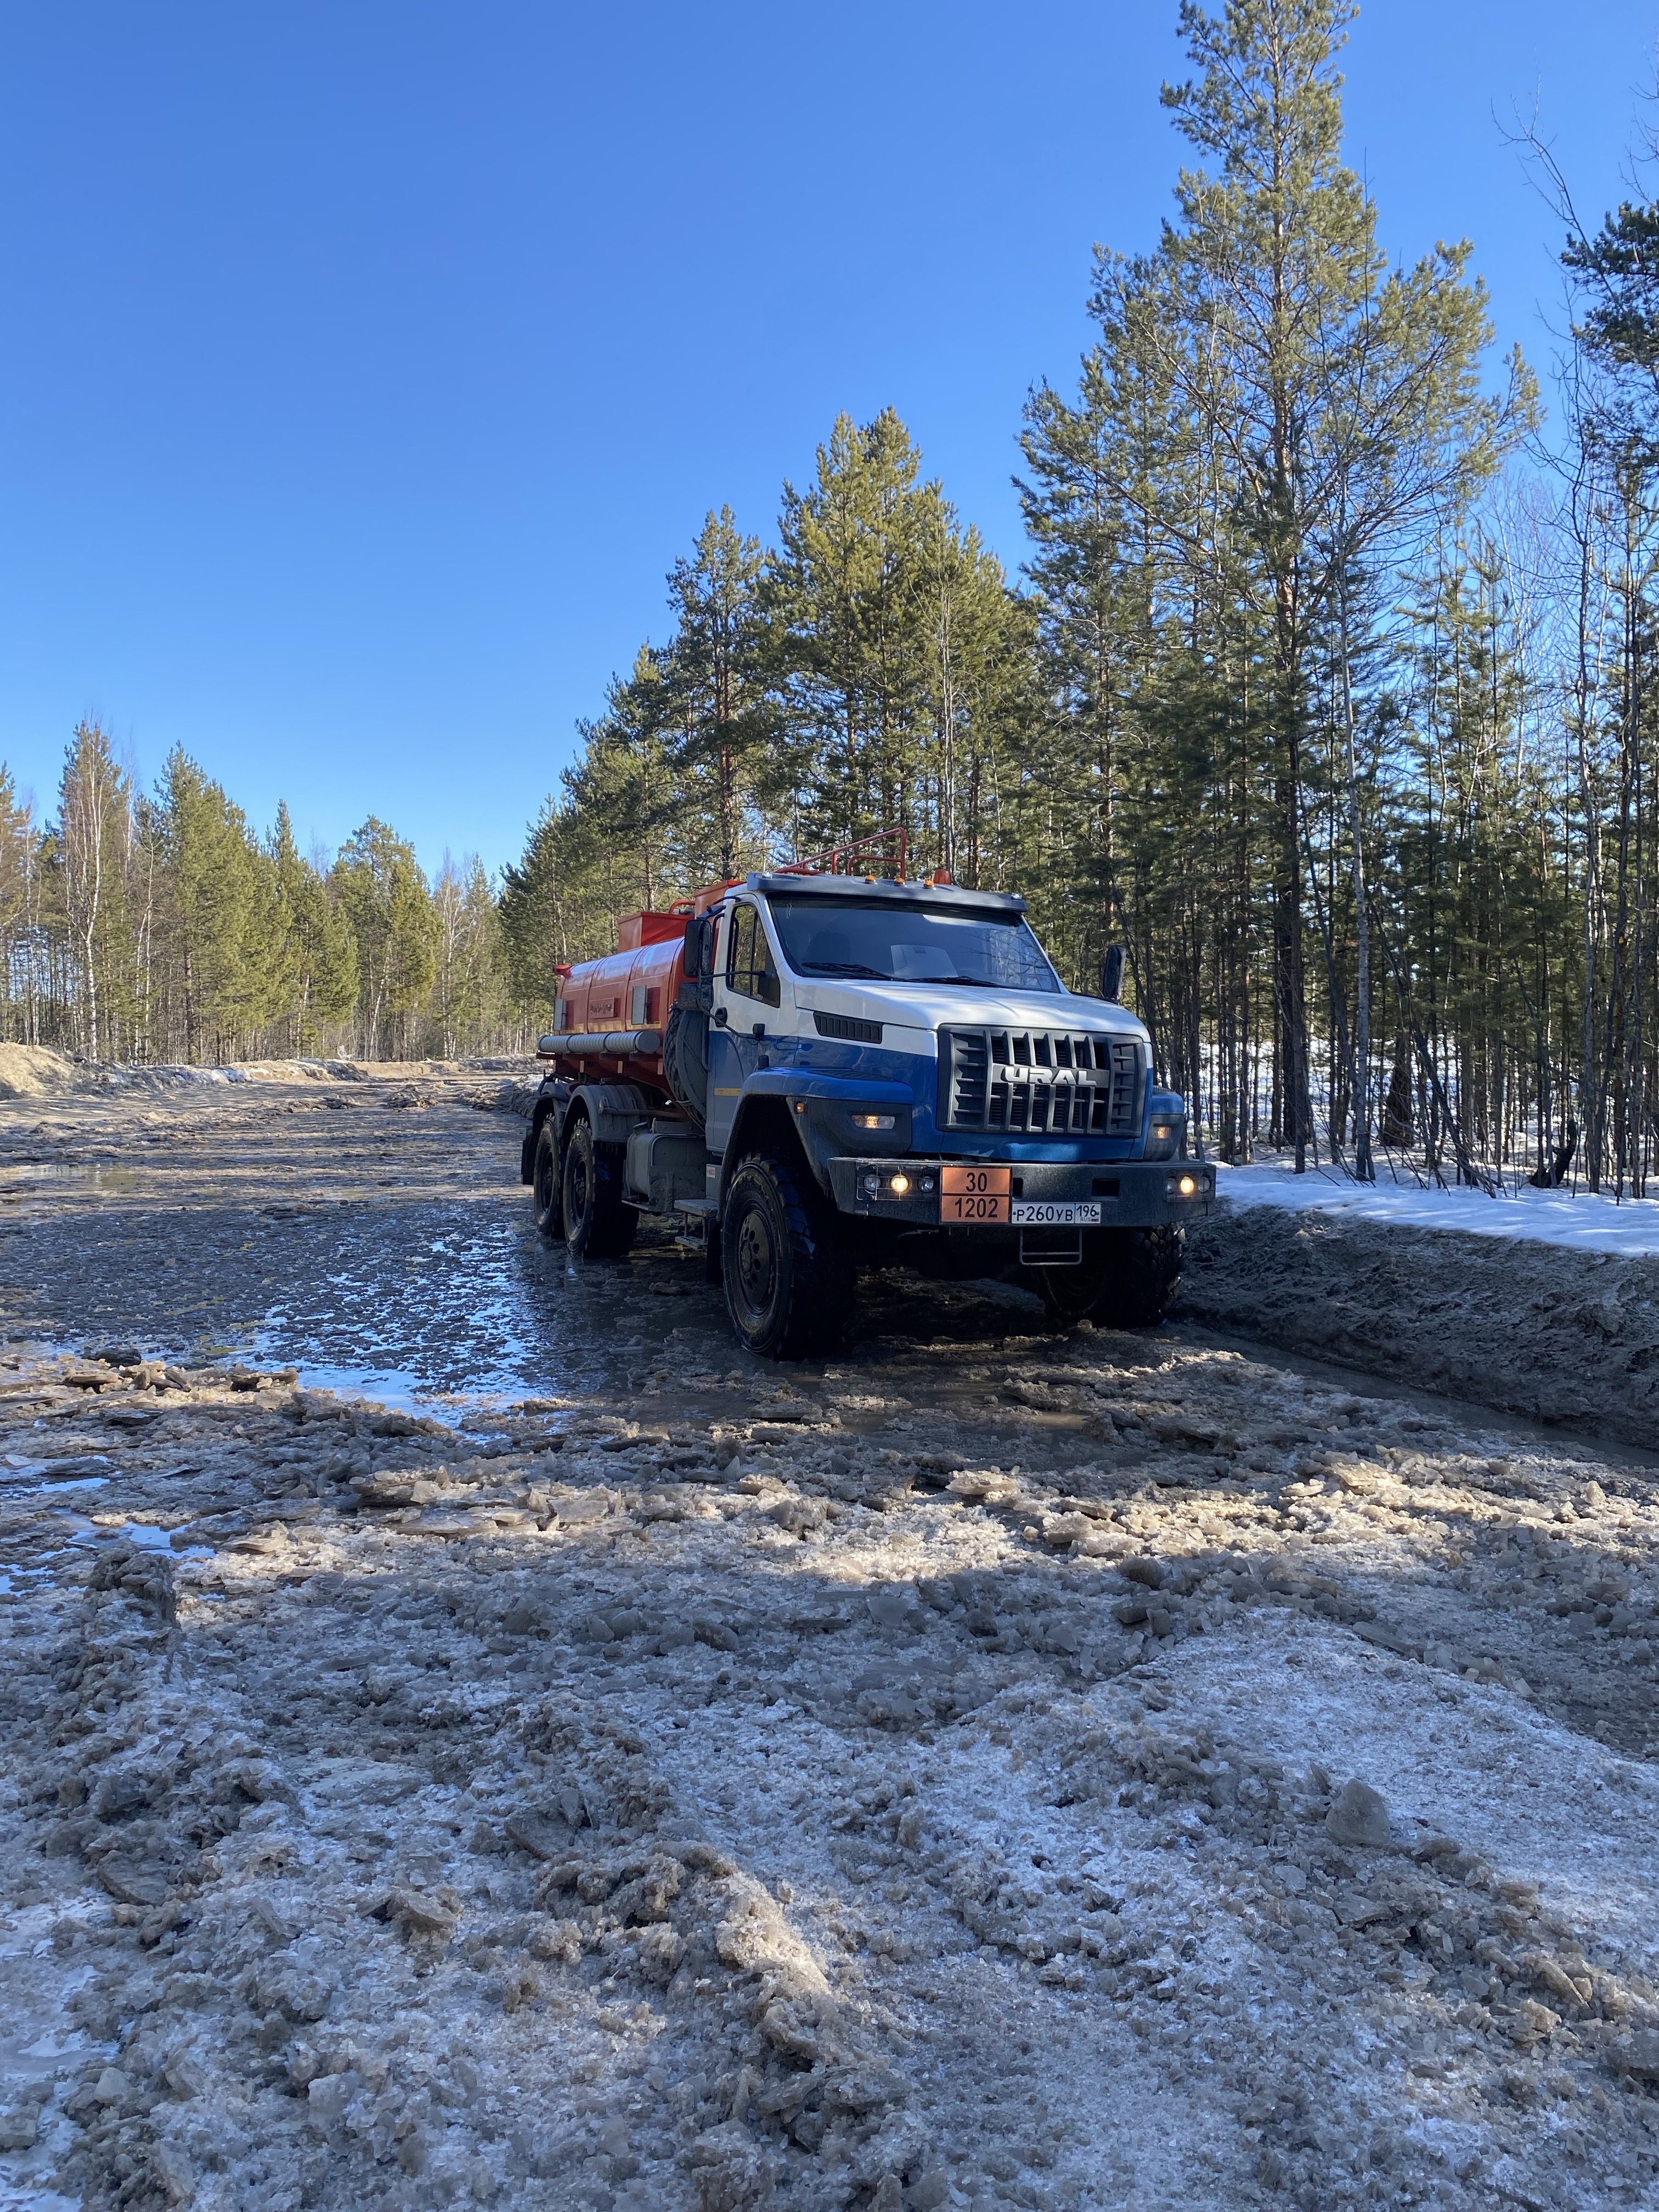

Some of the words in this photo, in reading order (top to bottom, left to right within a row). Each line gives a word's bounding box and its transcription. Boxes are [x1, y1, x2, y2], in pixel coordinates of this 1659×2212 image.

[1001, 1066, 1097, 1086] URAL
[966, 1172, 988, 1192] 30
[955, 1198, 998, 1218] 1202
[1076, 1204, 1097, 1217] 196
